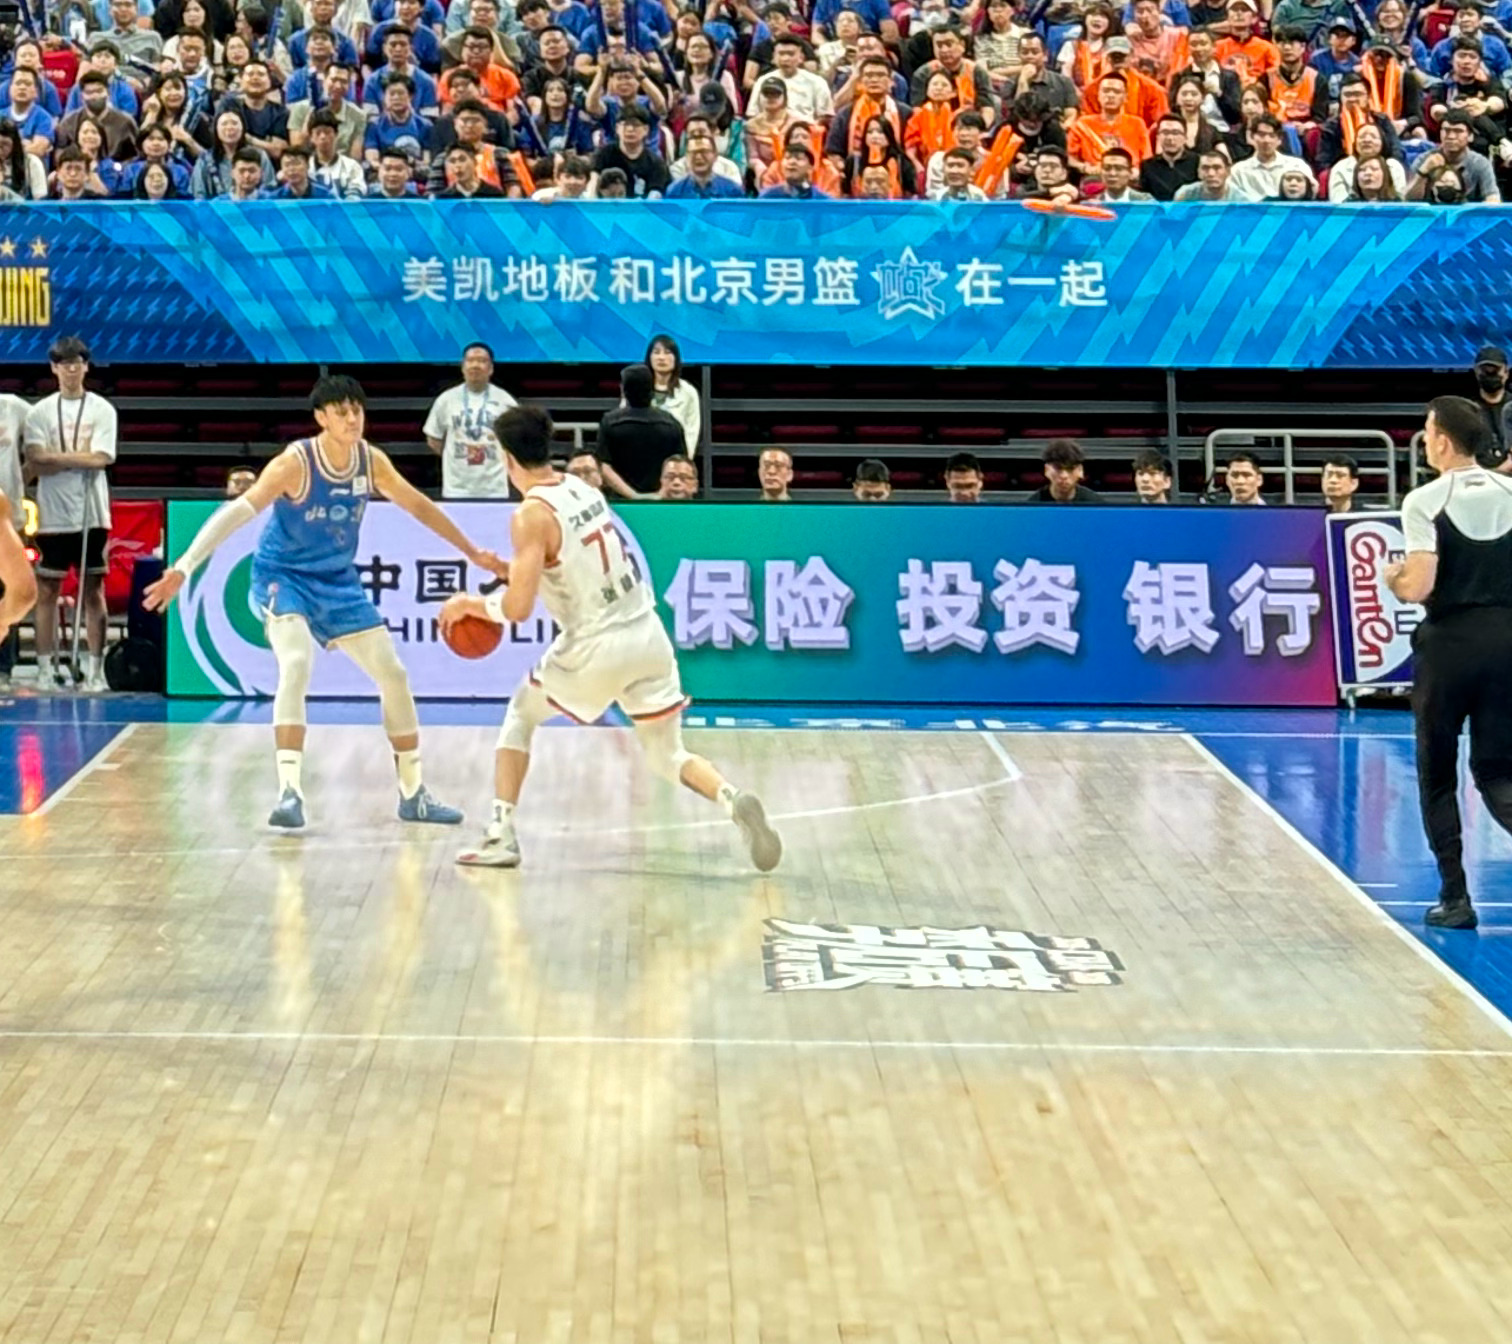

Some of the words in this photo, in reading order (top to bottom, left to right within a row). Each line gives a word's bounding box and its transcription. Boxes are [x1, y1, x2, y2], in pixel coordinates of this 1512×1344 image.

[956, 258, 1108, 308] 在一起
[665, 555, 856, 651] 保险
[897, 557, 1080, 654] 投资
[1125, 560, 1320, 655] 银行
